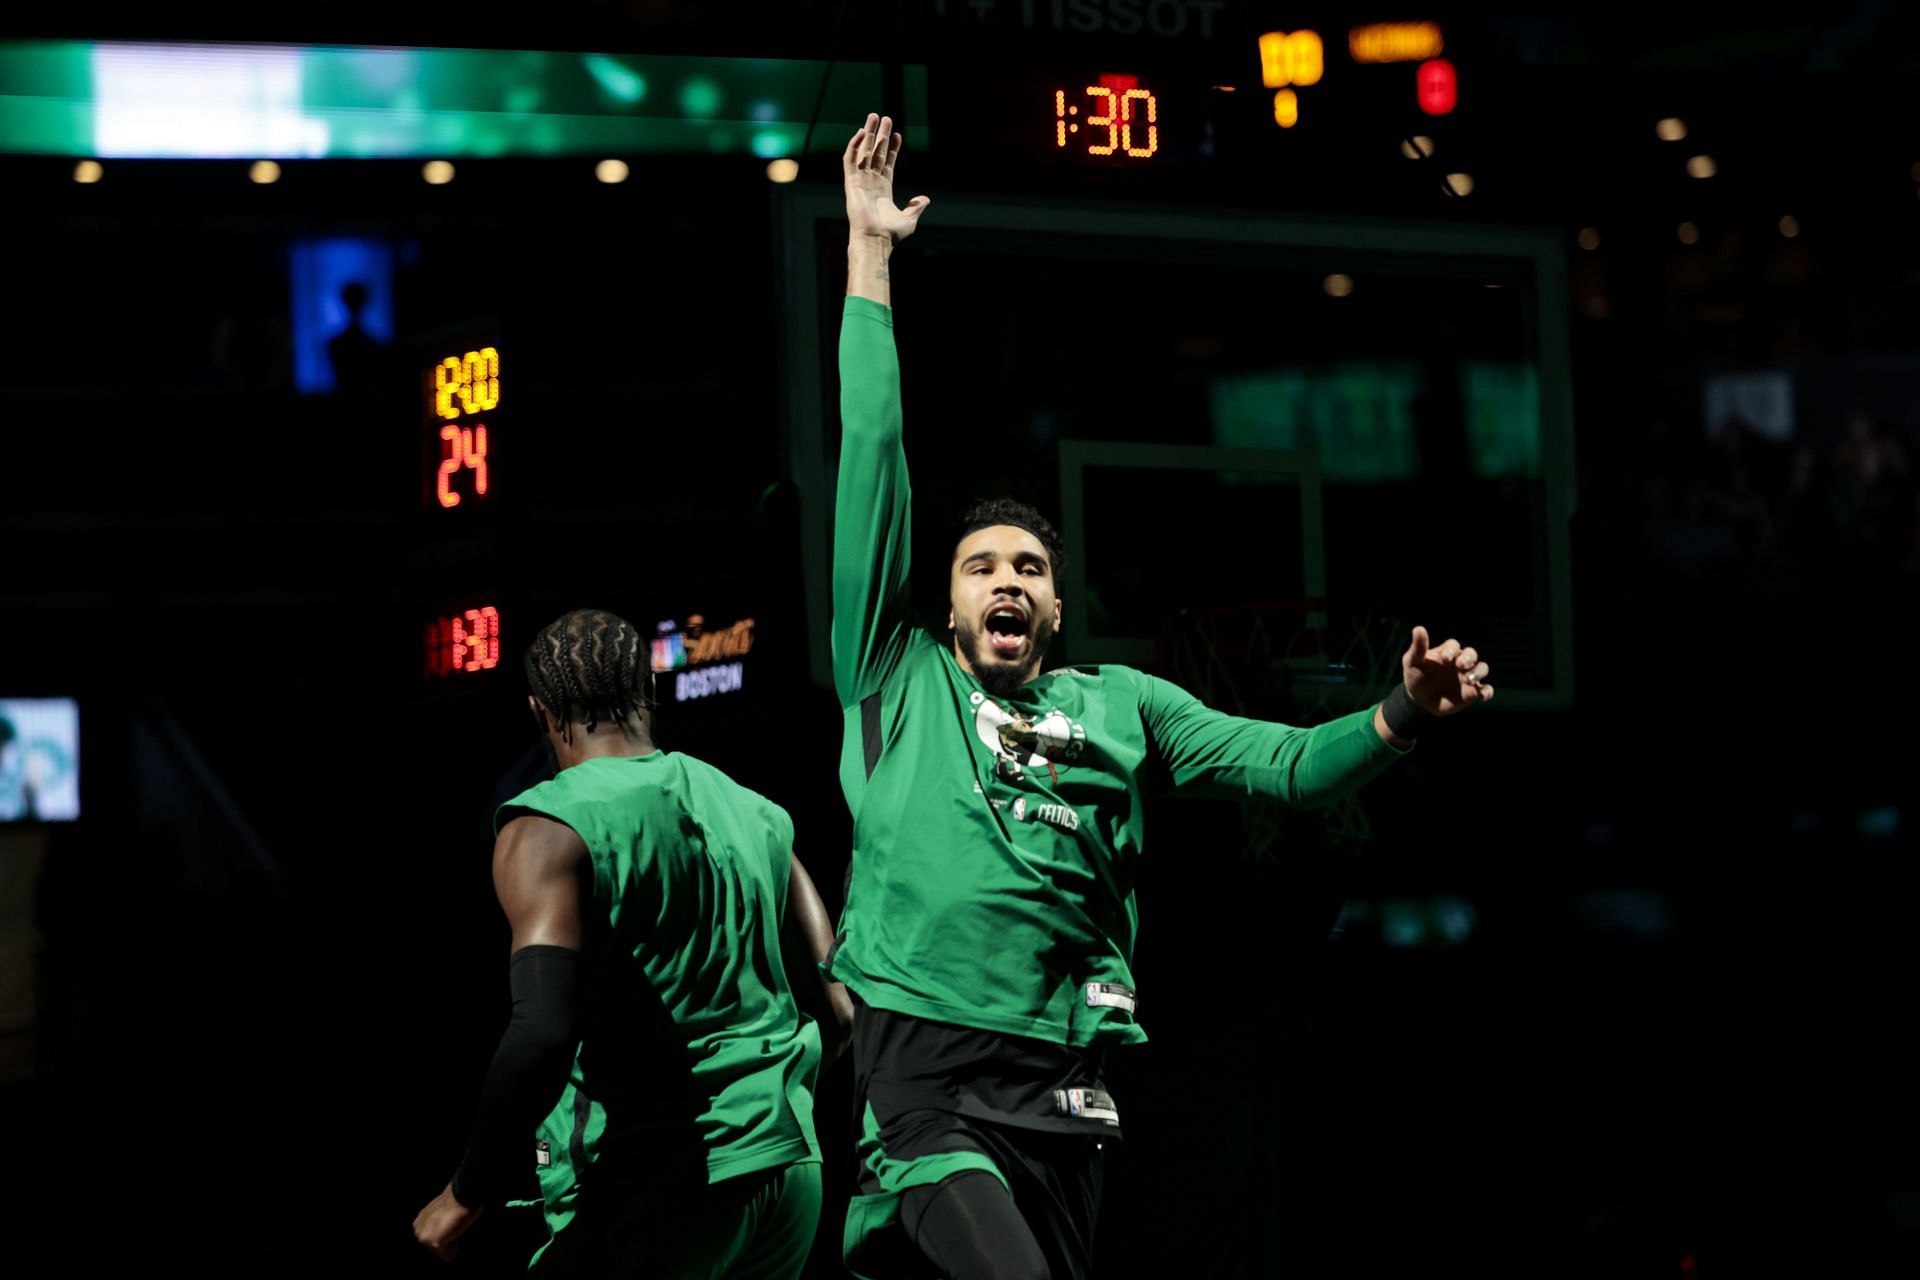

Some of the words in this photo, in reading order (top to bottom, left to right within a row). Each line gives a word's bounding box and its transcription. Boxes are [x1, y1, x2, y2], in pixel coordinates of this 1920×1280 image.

[1055, 86, 1158, 158] 1:30
[437, 423, 487, 508] 24
[676, 661, 743, 702] BOSTON
[1037, 803, 1079, 831] CELTICS
